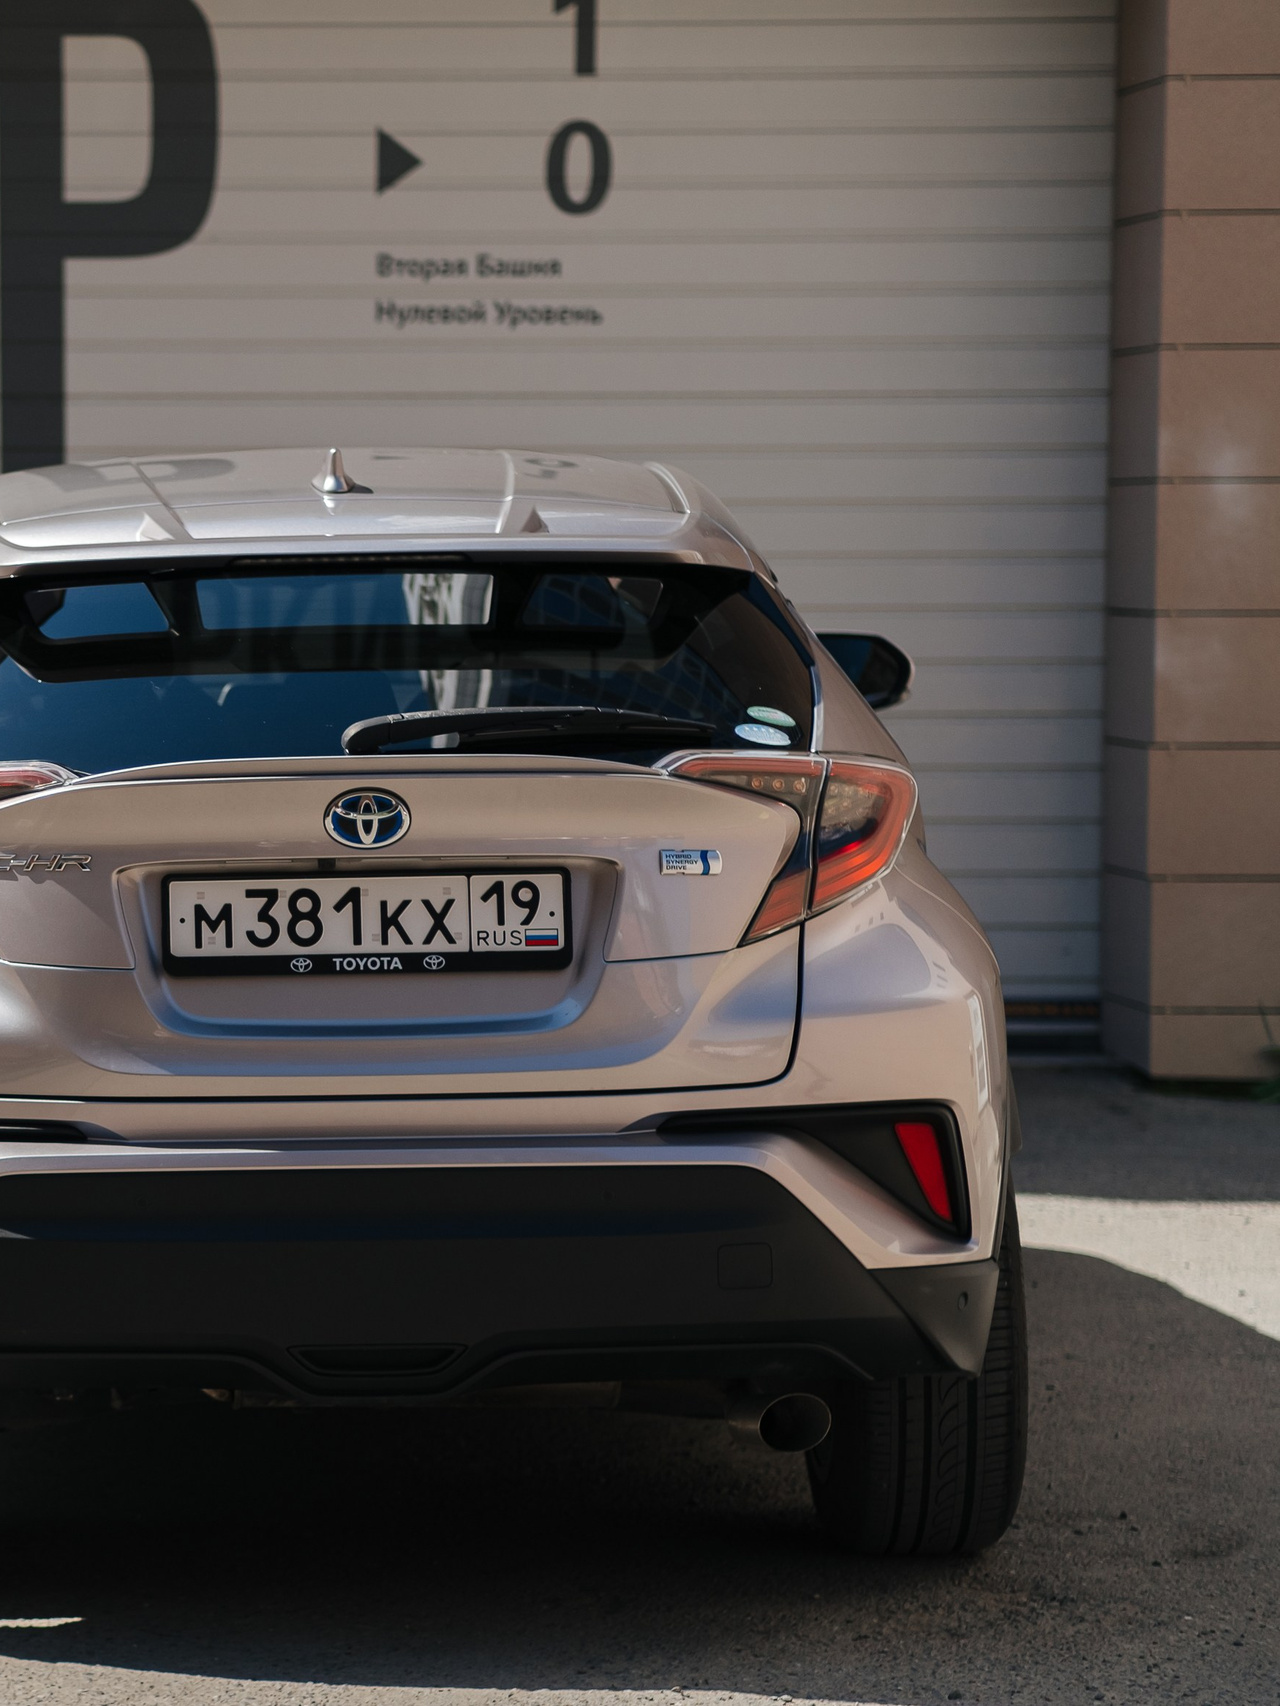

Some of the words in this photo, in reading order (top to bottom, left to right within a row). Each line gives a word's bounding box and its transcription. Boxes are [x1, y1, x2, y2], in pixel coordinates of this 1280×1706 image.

[552, 0, 598, 77] 1
[546, 119, 613, 216] 0
[376, 253, 468, 282] Вторая
[476, 253, 562, 278] Башня
[375, 300, 486, 330] Нулевой
[493, 300, 604, 330] Уровень
[480, 880, 541, 927] 19
[476, 930, 523, 947] RUS
[332, 957, 403, 972] TOYOTA
